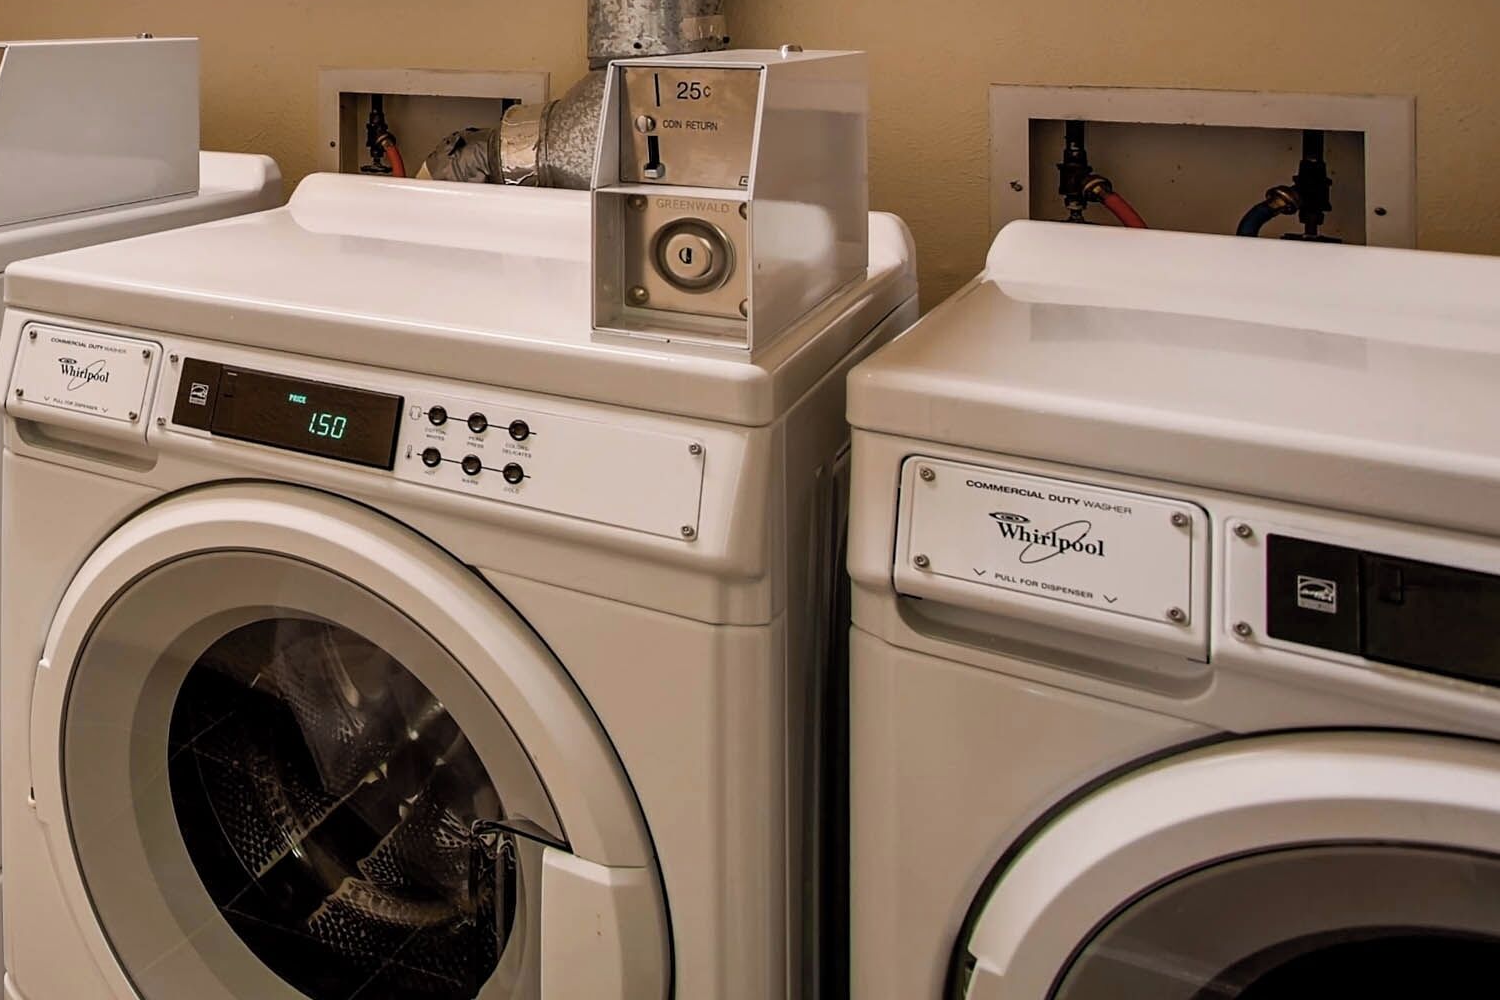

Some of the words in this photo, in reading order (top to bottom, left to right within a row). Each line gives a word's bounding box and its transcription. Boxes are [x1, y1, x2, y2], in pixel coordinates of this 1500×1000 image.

[662, 120, 682, 129] COIN
[686, 120, 718, 131] RETURN
[656, 199, 730, 214] GREENWALD
[61, 364, 109, 383] Whirlpool
[309, 413, 346, 439] 1.50
[966, 479, 1045, 499] COMMERCIAL
[1048, 494, 1080, 505] DUTY
[1083, 500, 1132, 514] WASHER
[996, 520, 1105, 557] Whirlpool
[994, 573, 1017, 584] PULL
[1020, 578, 1039, 588] FOR
[1041, 582, 1094, 599] DISPENSER
